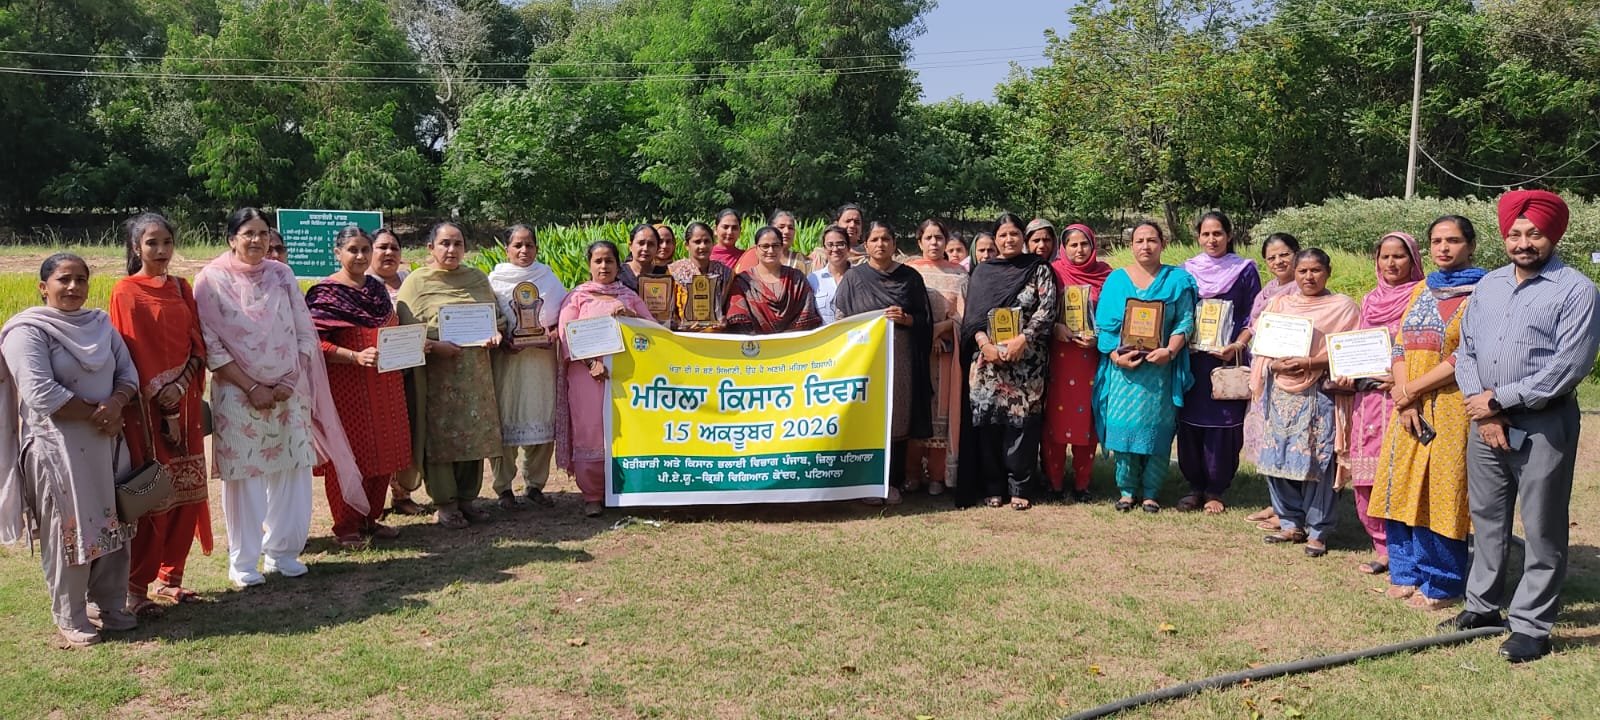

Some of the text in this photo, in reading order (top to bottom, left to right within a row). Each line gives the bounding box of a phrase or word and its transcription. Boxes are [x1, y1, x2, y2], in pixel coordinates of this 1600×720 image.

[632, 374, 869, 411] ਮਹਿਲਾ ਕਿਸਾਨ ਦਿਵਸ
[665, 416, 838, 449] 15 ਅਕਤੂਬਰ 2026
[622, 457, 660, 469] ਖੇਤੀਬਾੜੀ
[663, 457, 681, 468] ਅਤੇ
[685, 457, 714, 469] ਕਿਸਾਨ
[717, 457, 746, 469] ਭਲਾਈ
[750, 456, 779, 468] ਵਿਭਾਗ
[840, 452, 874, 463] ਪਟਿਆਲਾ
[728, 471, 769, 482] ਵਿਗਿਆਨ
[805, 468, 844, 479] ਪਟਿਆਲਾ
